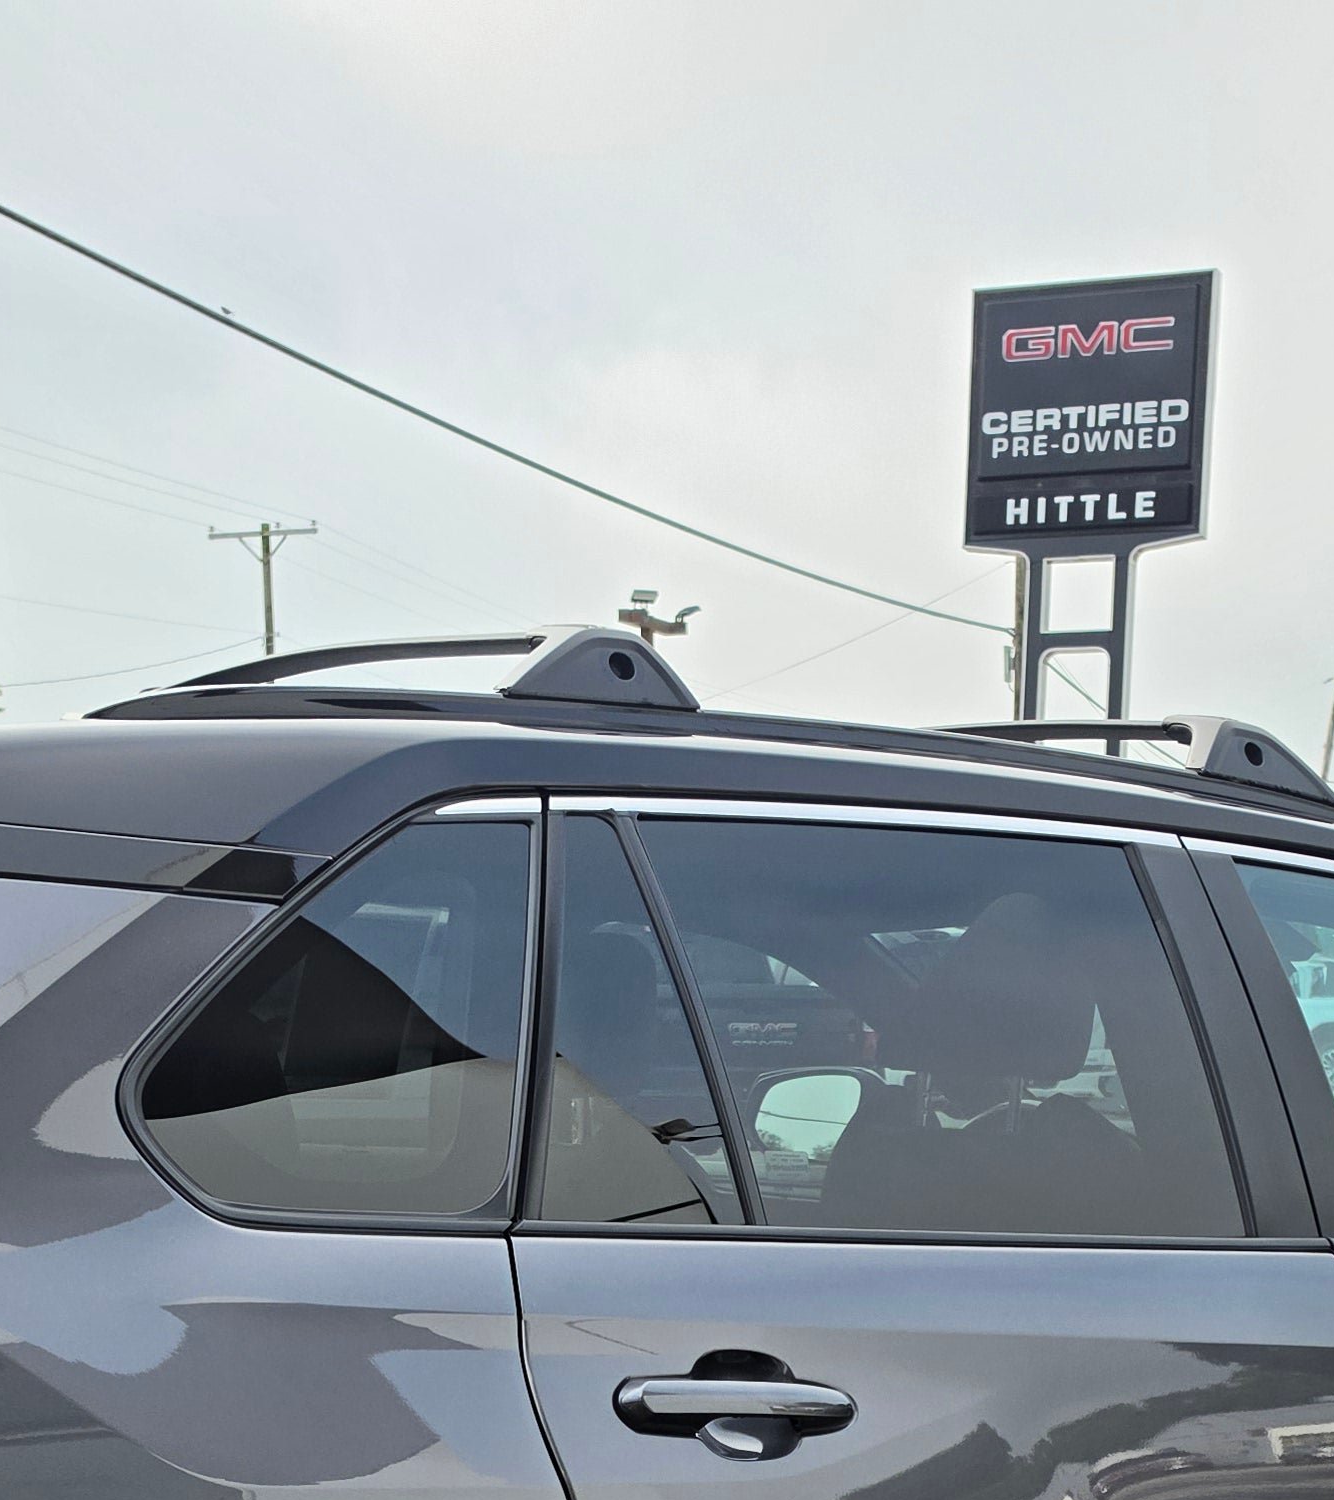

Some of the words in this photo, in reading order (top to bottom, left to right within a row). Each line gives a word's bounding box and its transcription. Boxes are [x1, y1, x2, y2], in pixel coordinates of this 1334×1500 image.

[1002, 316, 1175, 362] GMC
[982, 399, 1189, 435] CERTIFIED
[991, 426, 1177, 459] PRE-OWNED
[1006, 491, 1157, 525] HITTLE
